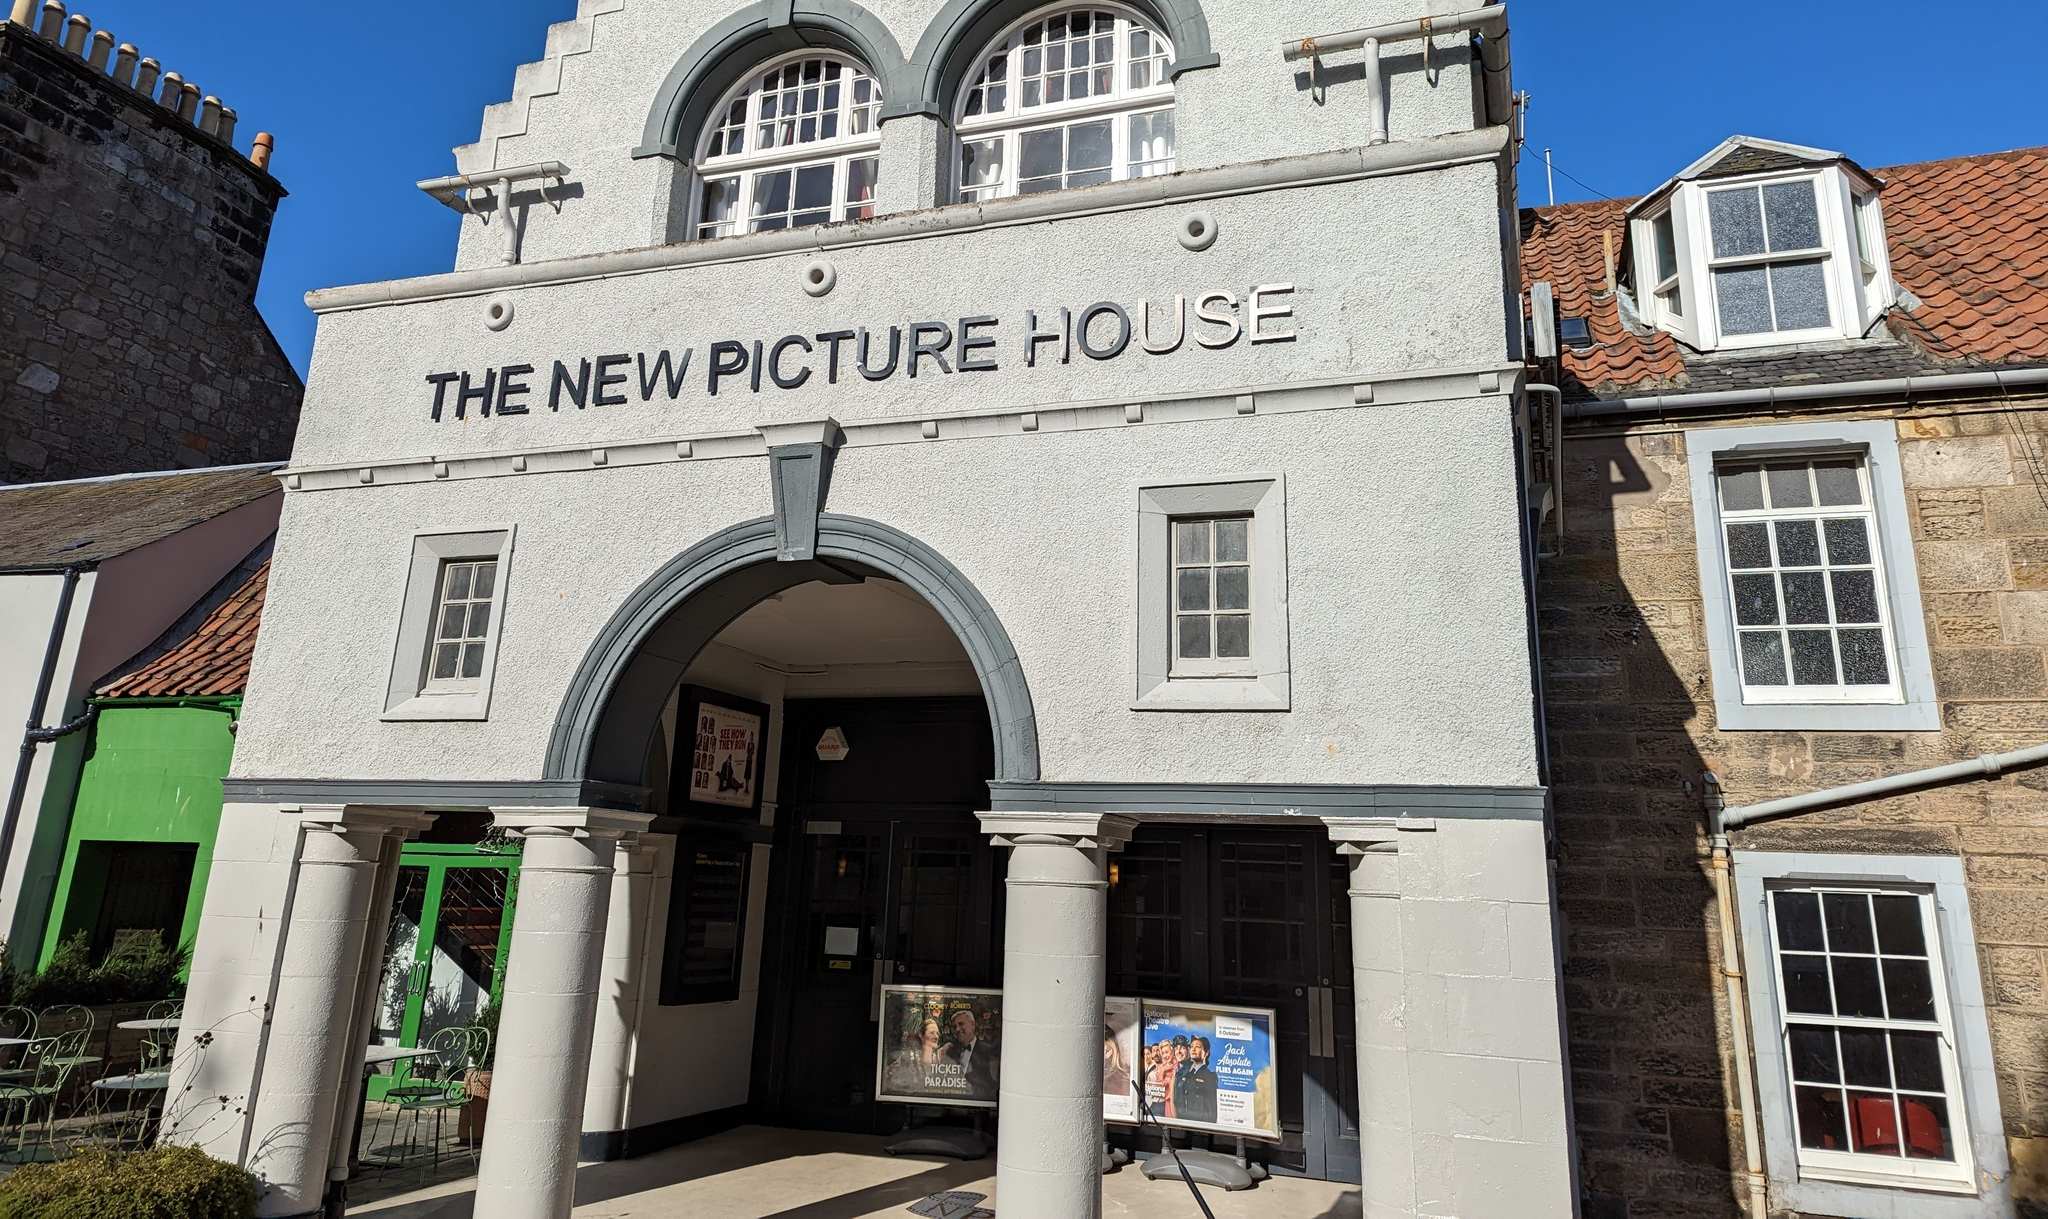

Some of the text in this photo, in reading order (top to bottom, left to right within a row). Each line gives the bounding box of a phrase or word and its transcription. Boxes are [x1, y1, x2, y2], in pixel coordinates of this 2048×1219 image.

[426, 281, 1297, 423] THE NEW PICTURE HOUSE
[720, 728, 747, 740] SEE HOW
[719, 739, 734, 750] THEY
[1225, 1043, 1246, 1055] Jack
[1217, 1054, 1252, 1067] Absolute
[930, 1063, 962, 1074] TICKET
[1216, 1066, 1254, 1076] FLIES AGAIN
[924, 1076, 967, 1088] PARADISE
